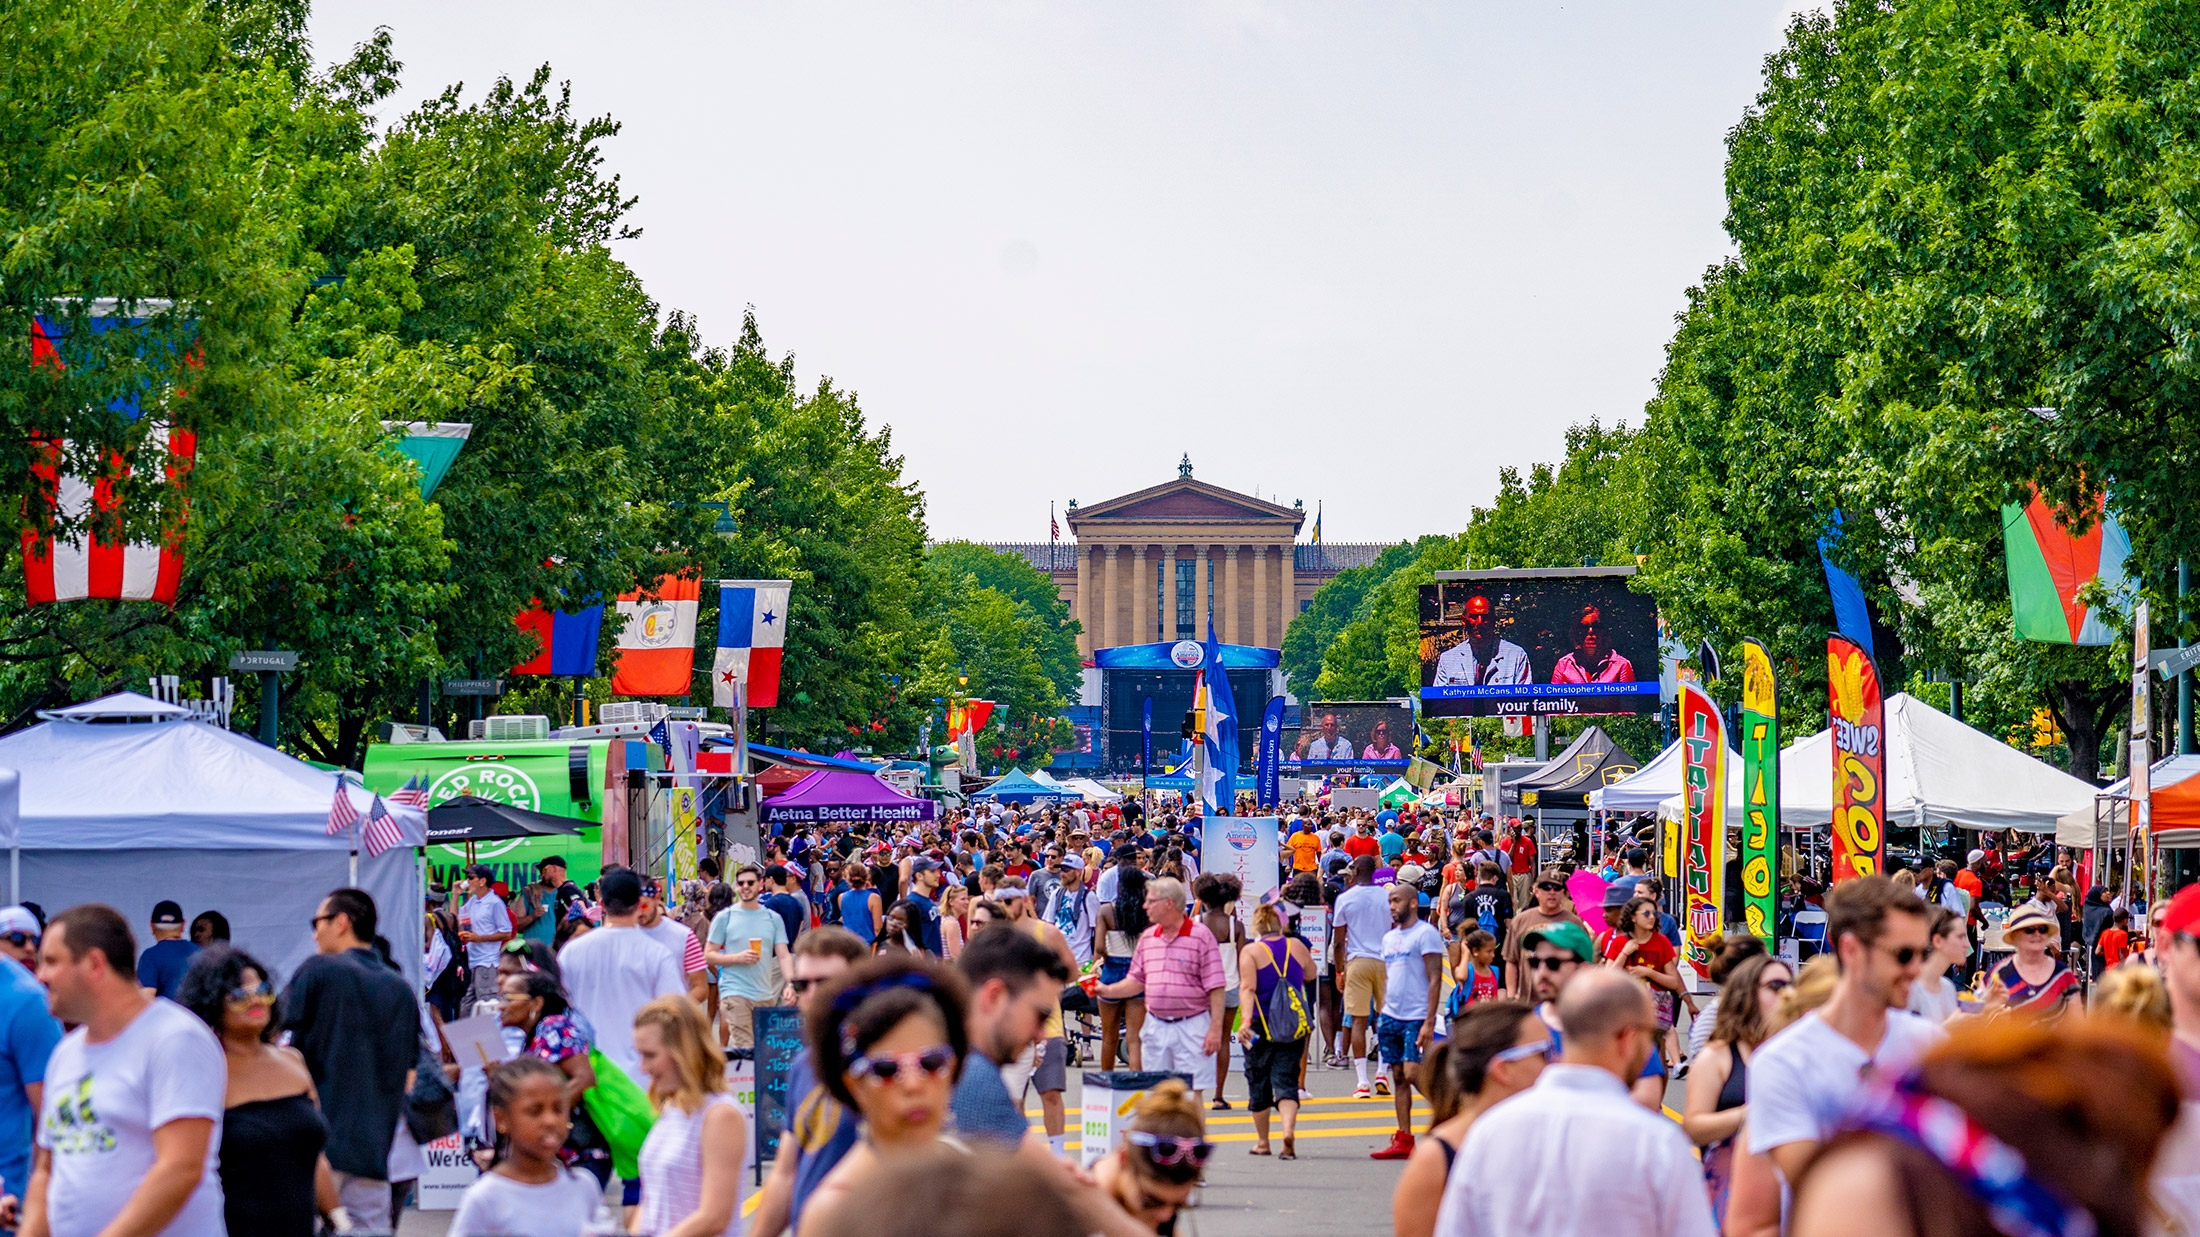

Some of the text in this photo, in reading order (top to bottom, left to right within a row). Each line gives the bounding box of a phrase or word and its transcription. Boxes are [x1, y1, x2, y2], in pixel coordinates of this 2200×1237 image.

[240, 657, 286, 665] PORTUGAL
[1442, 688, 1475, 697] Kathyrn
[1532, 686, 1544, 694] St.
[1545, 685, 1602, 695] Christopher's
[1604, 684, 1638, 694] Hospital
[1496, 698, 1579, 714] your family,
[1264, 739, 1275, 799] Information
[768, 807, 814, 821] Aetna
[819, 806, 867, 820] Better
[1373, 876, 1394, 884] aetna
[1301, 924, 1323, 932] erica
[1308, 935, 1325, 943] tiful
[428, 1150, 470, 1168] We're
